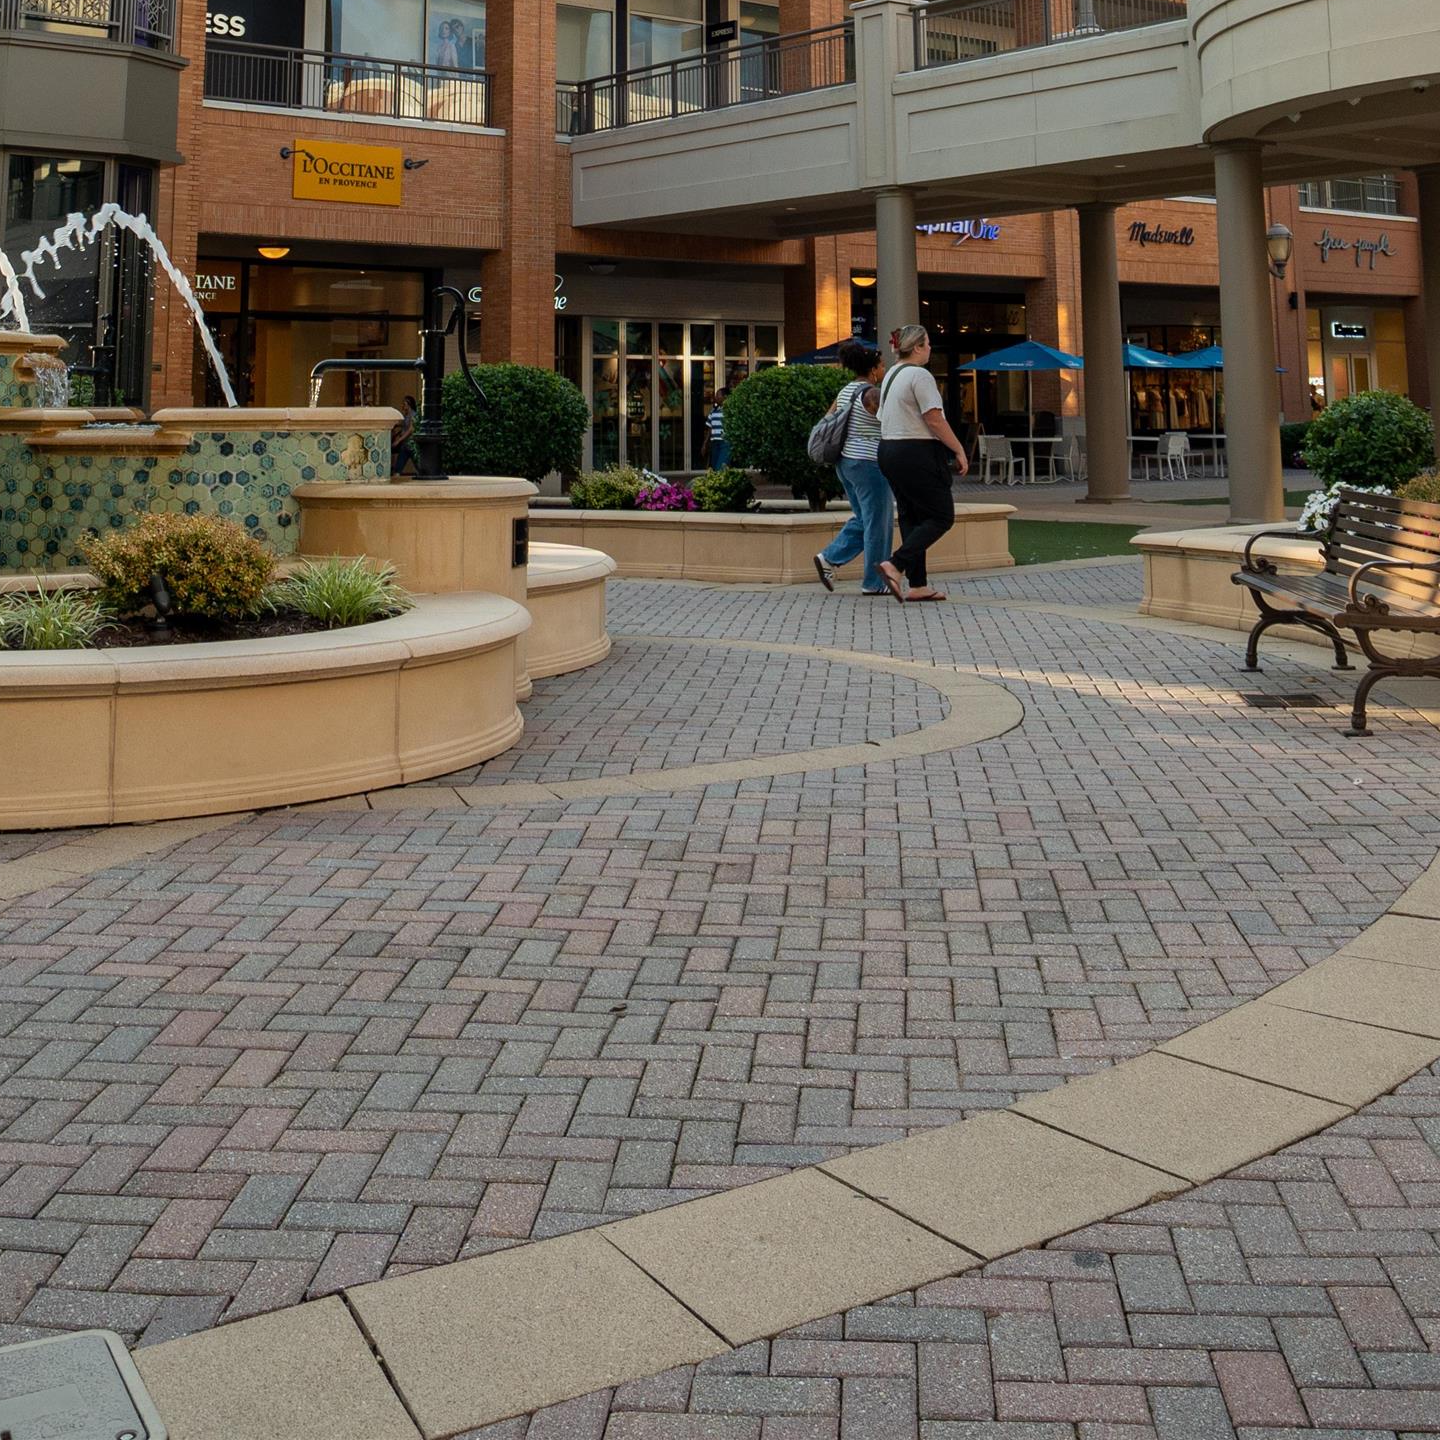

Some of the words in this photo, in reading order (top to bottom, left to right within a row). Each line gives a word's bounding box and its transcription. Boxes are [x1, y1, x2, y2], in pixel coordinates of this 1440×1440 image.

[319, 177, 330, 185] EN
[333, 178, 377, 189] PROVENCE
[1127, 222, 1195, 247] Madewell
